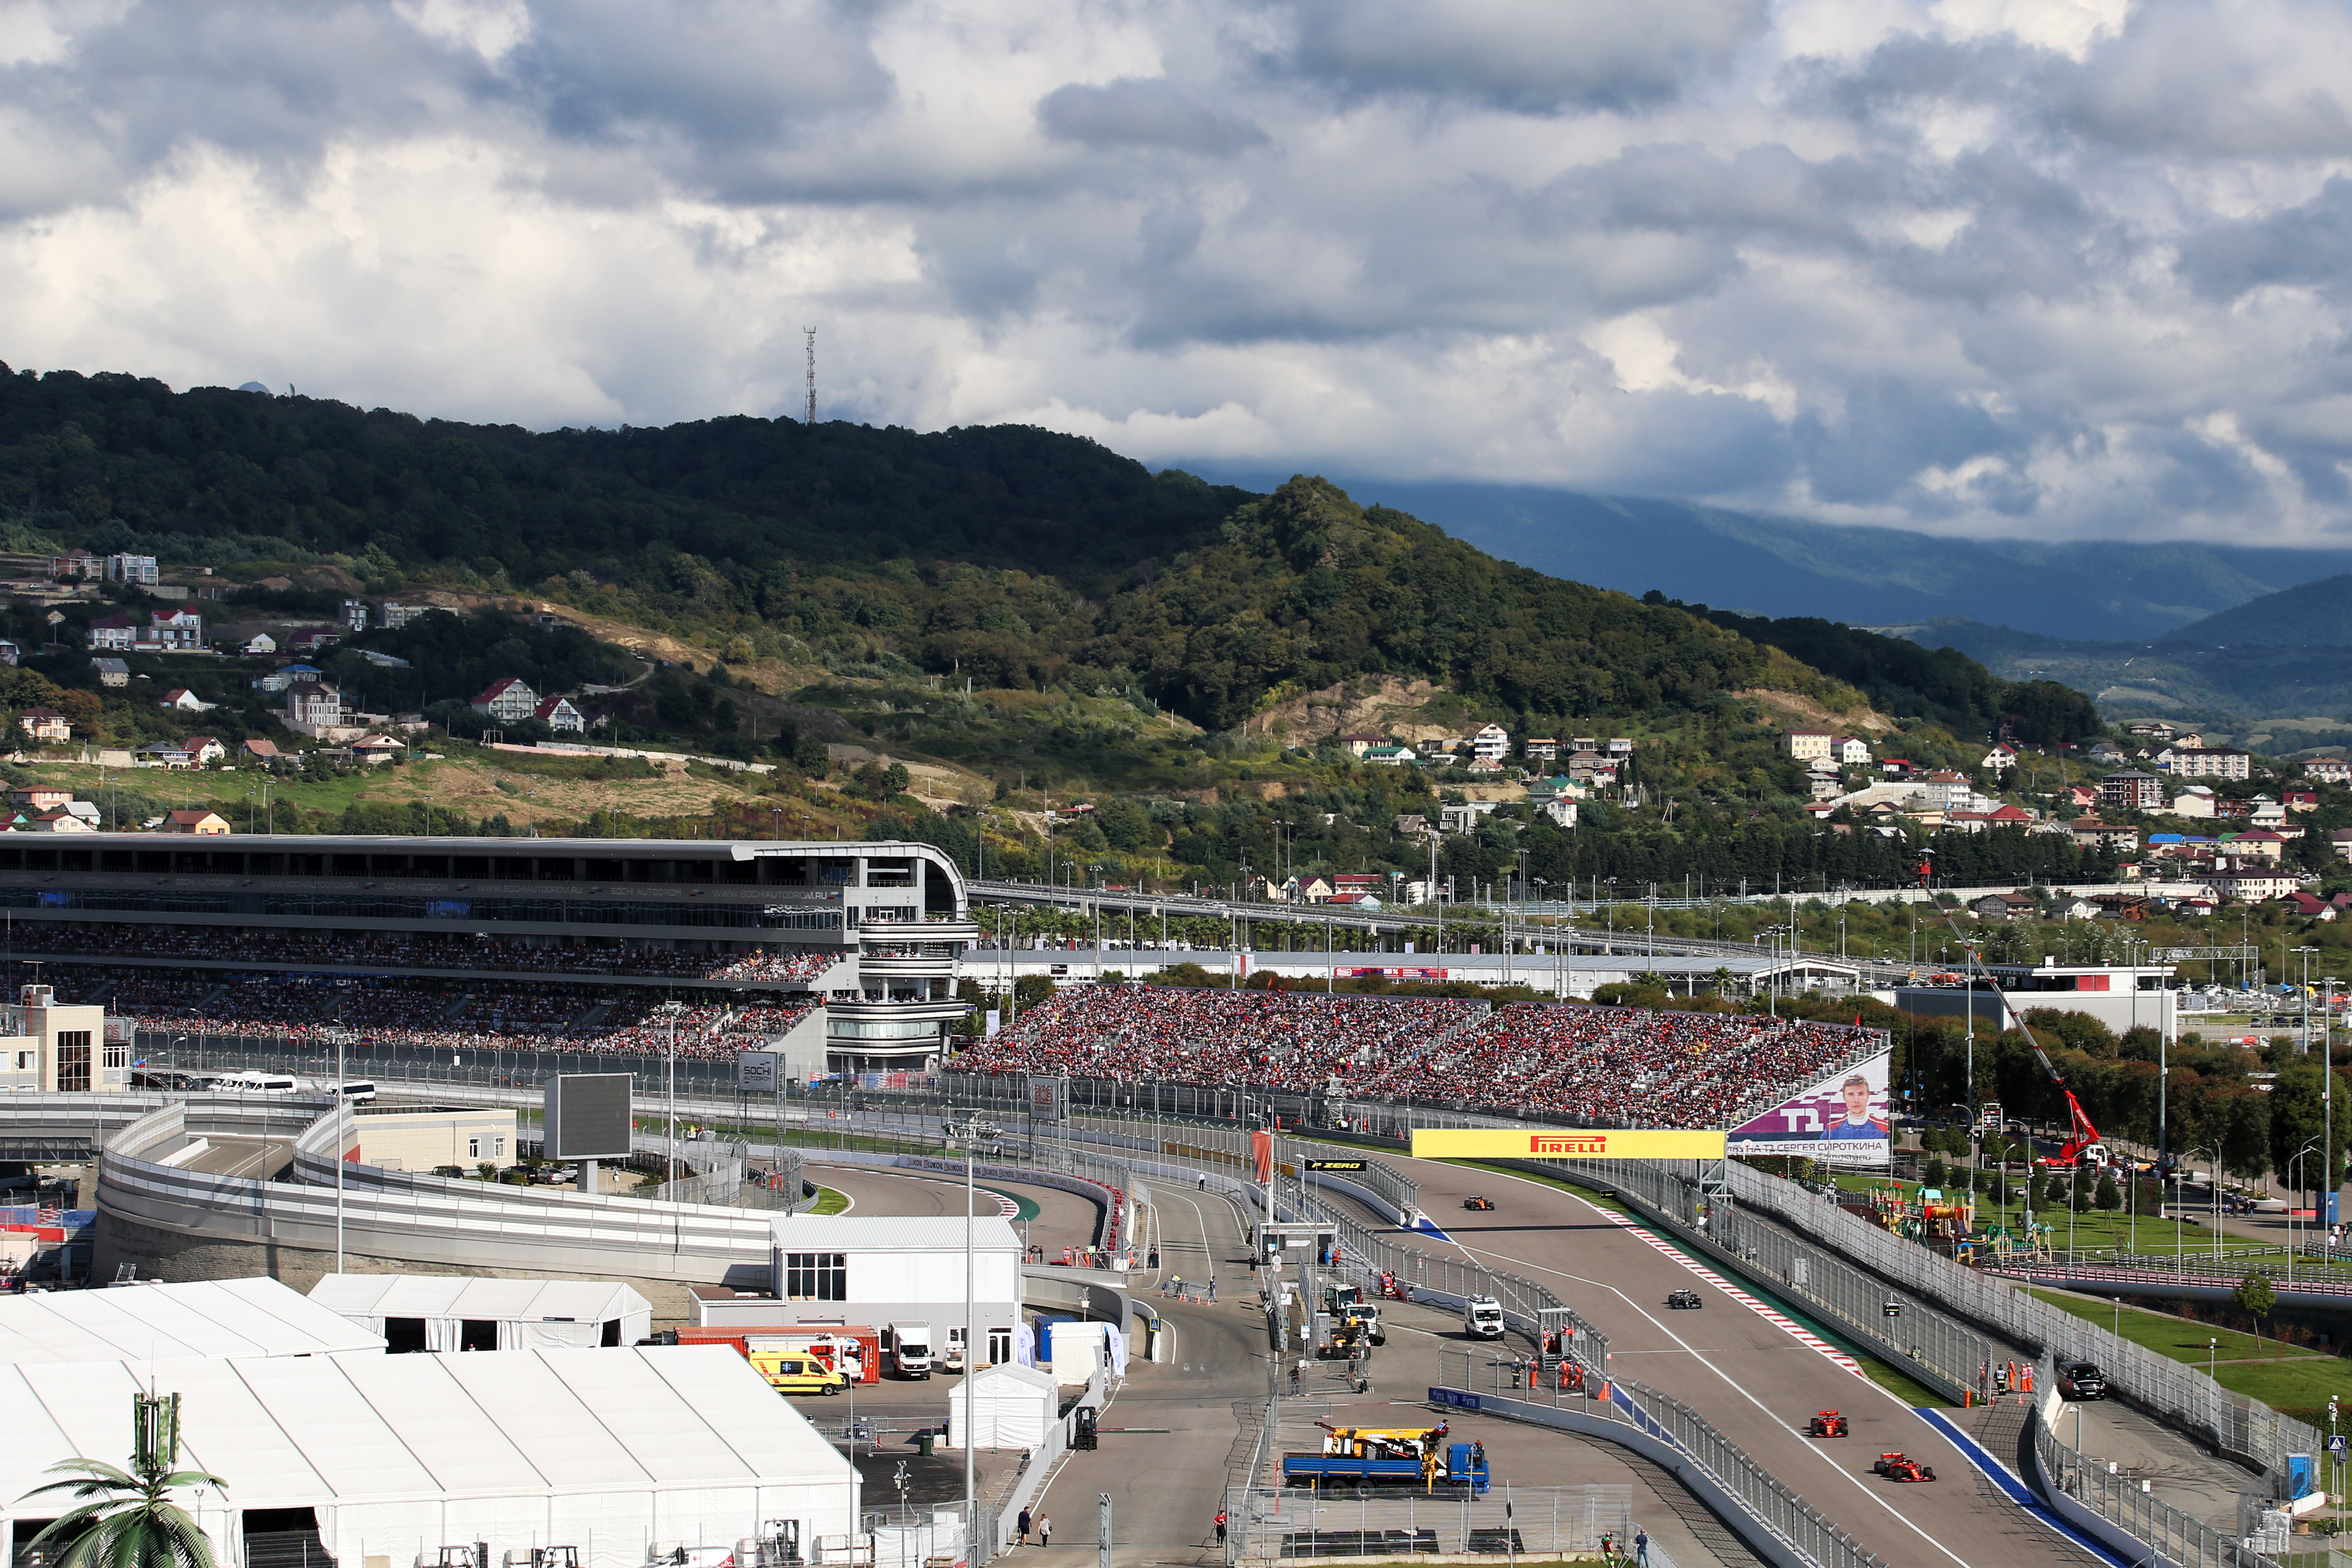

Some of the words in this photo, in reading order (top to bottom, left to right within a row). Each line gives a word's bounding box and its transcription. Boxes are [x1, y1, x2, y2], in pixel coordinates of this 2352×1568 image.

[261, 880, 358, 889] WWW.SOCHIAUTODROM.RU
[408, 883, 449, 892] АВТОДРОМ
[478, 884, 582, 894] WWW.SOCHIAUTODROM.RU
[712, 890, 828, 900] WWW.SOCHIAUTODROM.RU
[744, 1066, 771, 1075] SOCHI
[1035, 1084, 1053, 1105] ROS
[1530, 1136, 1607, 1152] PIRELLI
[1818, 1142, 1882, 1151] СИРОТКИНА
[928, 1160, 943, 1170] LUKOIL
[948, 1161, 963, 1172] LUKOIL
[985, 1168, 998, 1176] LUKOIL
[1003, 1170, 1014, 1178] LUKOIL
[1436, 1392, 1445, 1401] VTB
[1466, 1398, 1475, 1406] VTB
